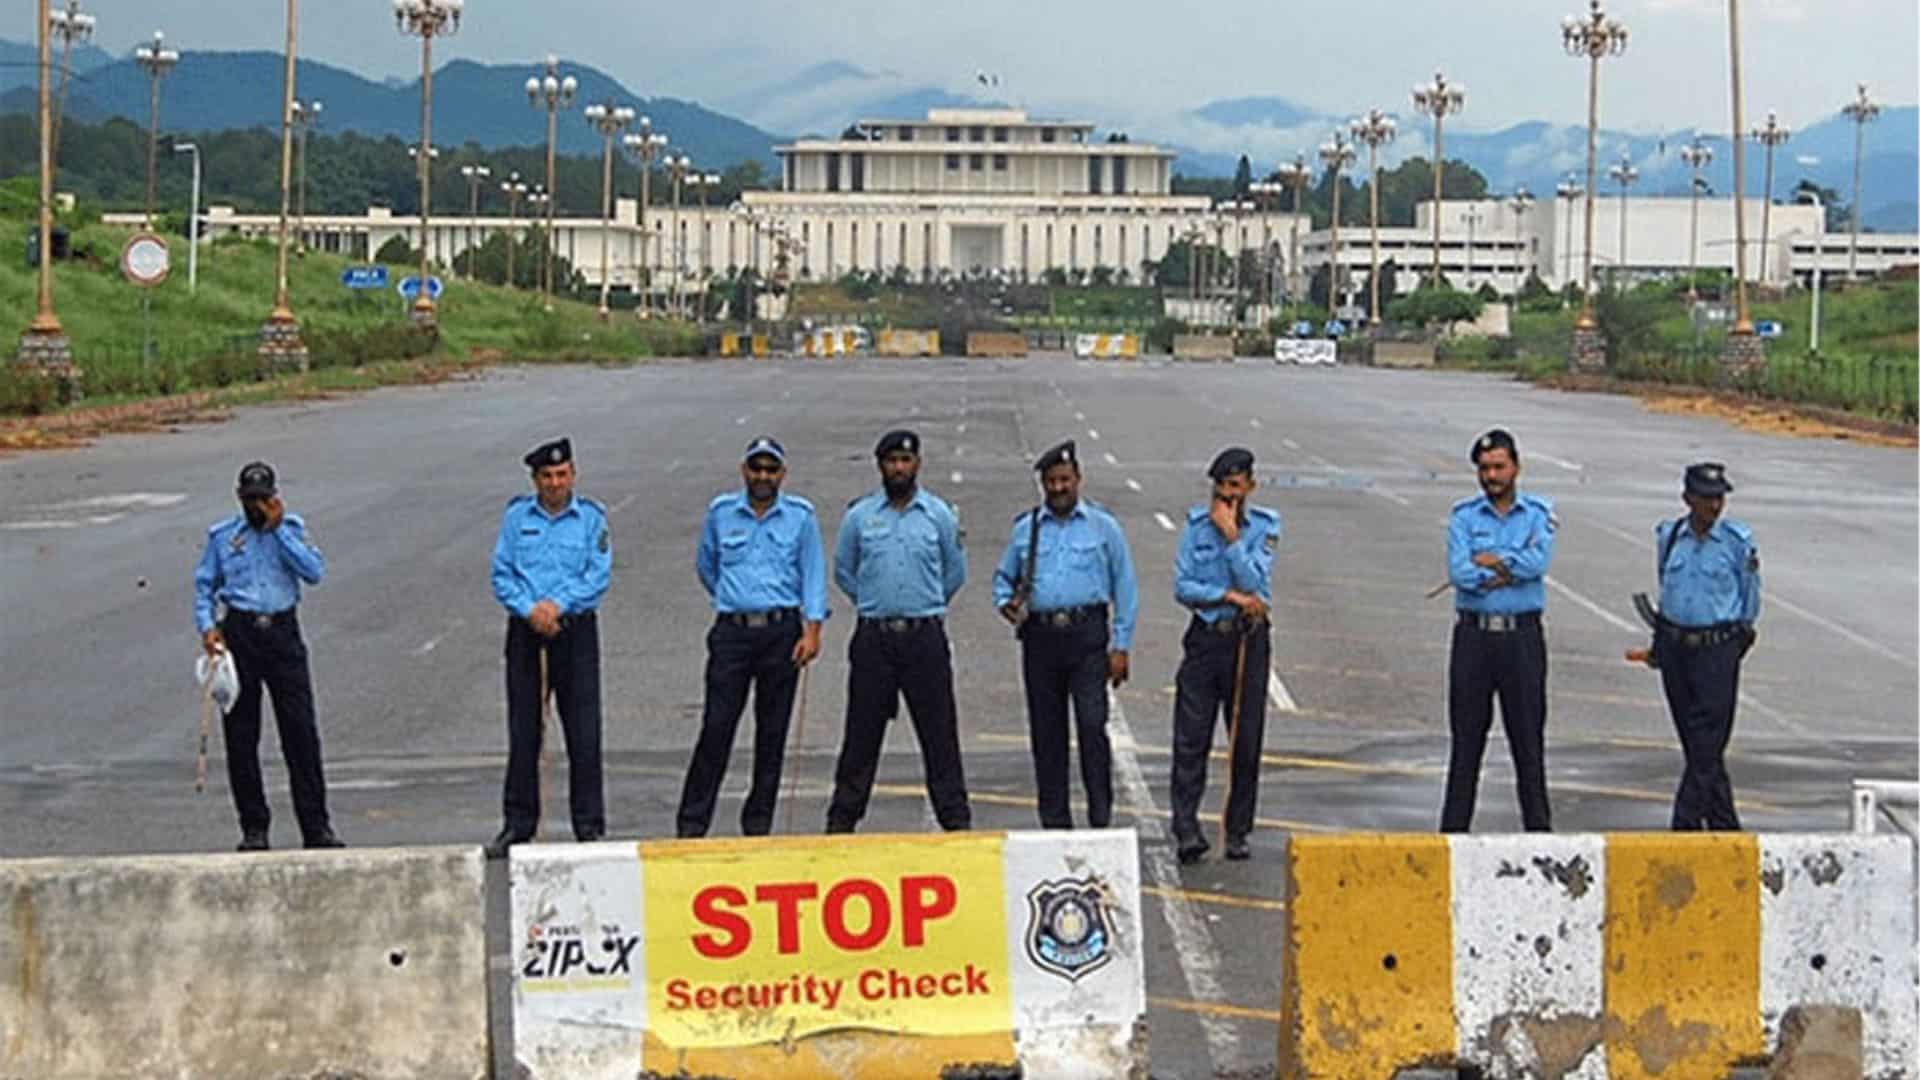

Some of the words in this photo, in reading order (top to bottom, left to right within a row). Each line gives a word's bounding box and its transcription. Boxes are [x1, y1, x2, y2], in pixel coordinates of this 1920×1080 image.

[691, 873, 958, 961] STOP
[665, 974, 844, 1010] Security
[857, 964, 990, 1001] Check
